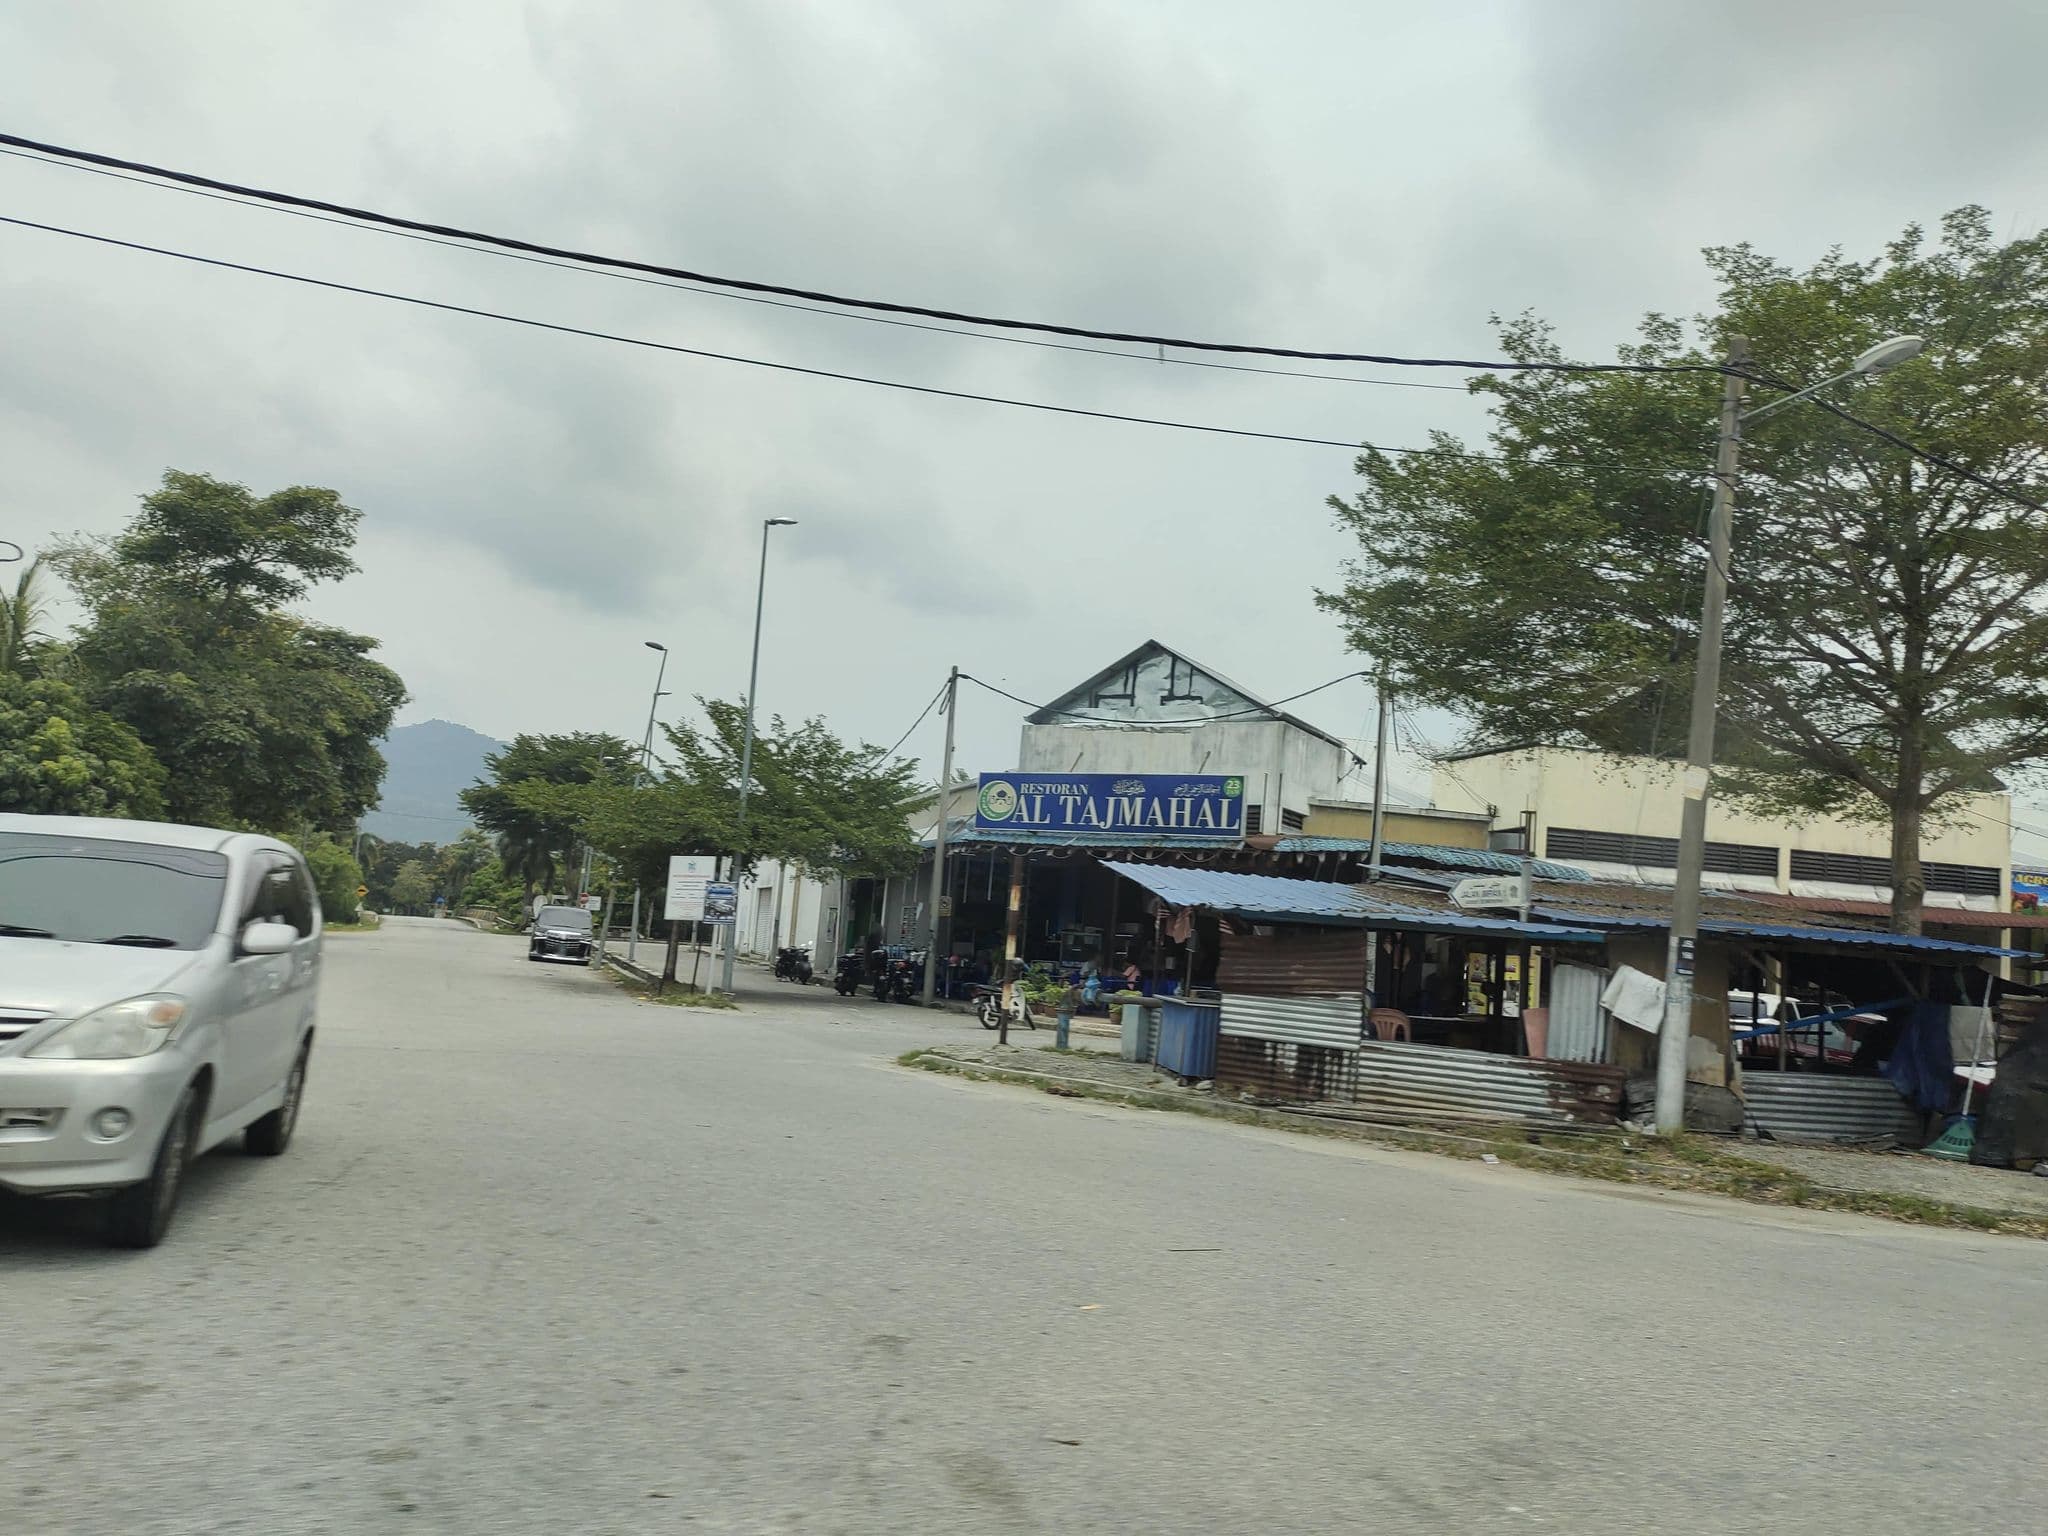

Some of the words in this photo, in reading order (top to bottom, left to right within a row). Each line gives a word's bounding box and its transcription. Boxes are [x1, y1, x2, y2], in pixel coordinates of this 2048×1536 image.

[1020, 783, 1089, 795] RESTORAN
[1010, 795, 1051, 824] AL
[1059, 795, 1240, 829] TAJMAHAL
